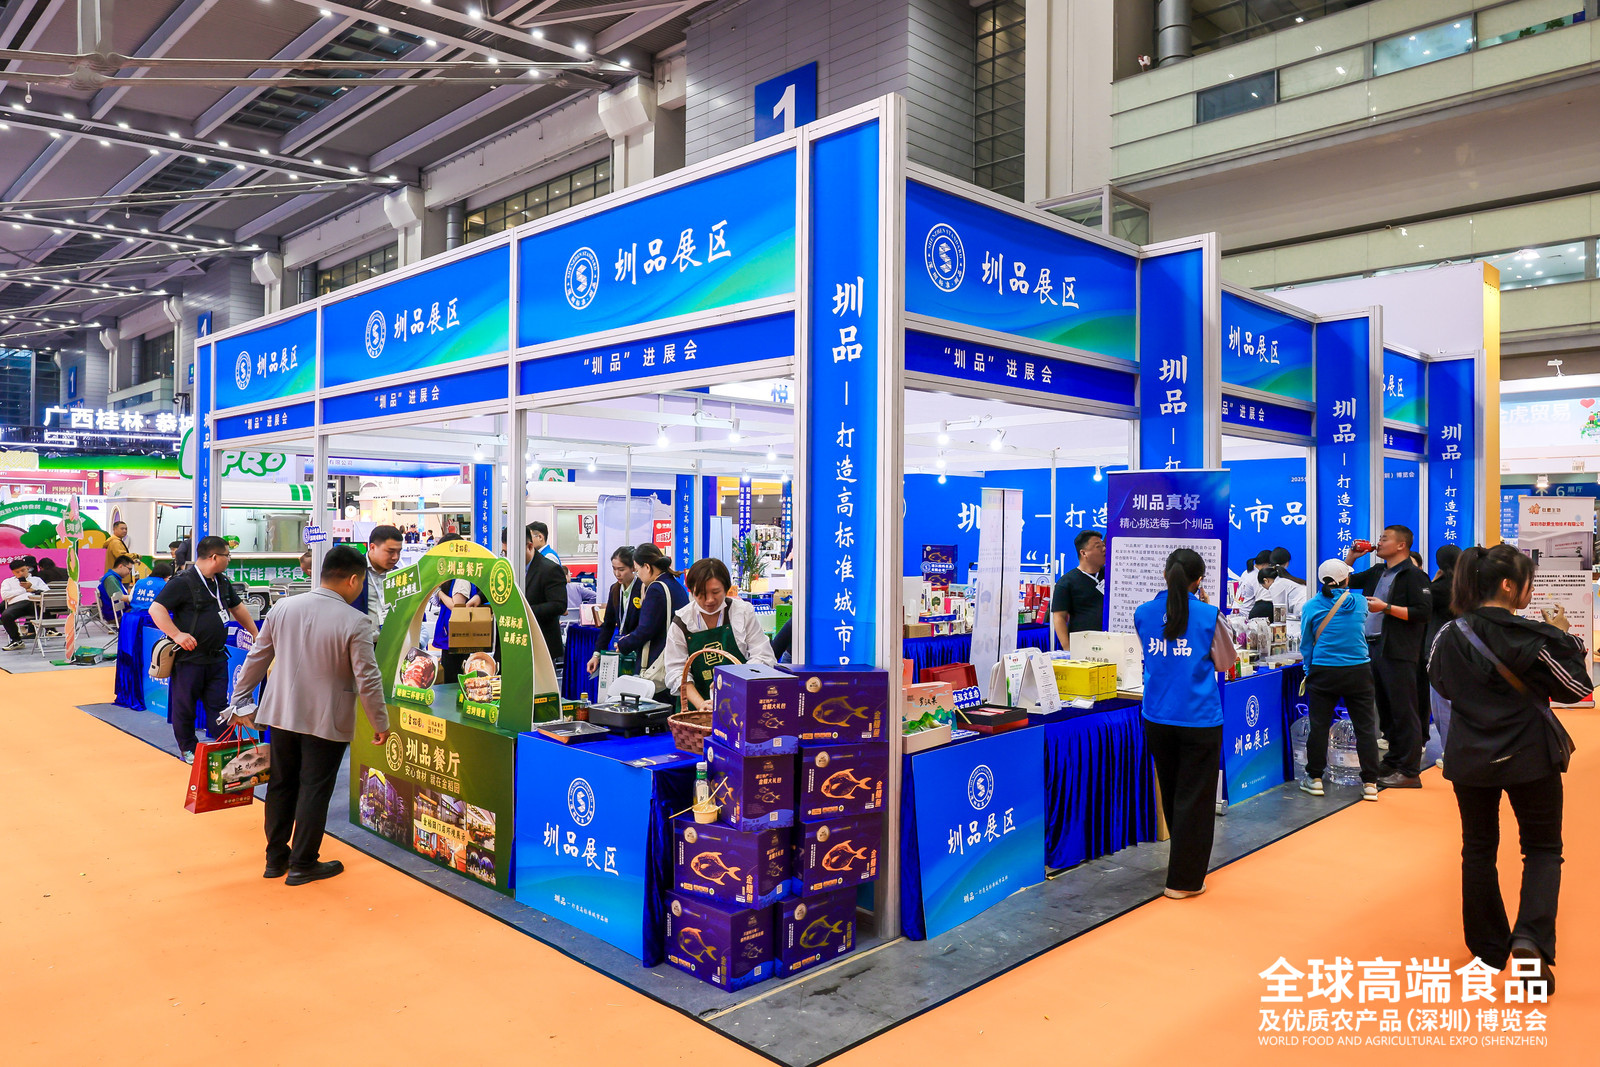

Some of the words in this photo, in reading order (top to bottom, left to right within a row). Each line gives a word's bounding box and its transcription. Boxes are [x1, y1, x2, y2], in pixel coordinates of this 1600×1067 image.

[773, 84, 795, 132] 1
[614, 219, 732, 285] 圳品展区
[982, 251, 1080, 309] 圳品展区
[394, 297, 460, 342] 圳品展区
[257, 344, 298, 378] 圳品展区
[1229, 325, 1280, 364] 圳品展区
[1132, 493, 1201, 511] 圳品真好
[1441, 423, 1462, 545] 圳品—打造高标
[1119, 517, 1214, 530] 精心挑选每一个圳品
[447, 560, 484, 578] 圳品餐厅
[1148, 637, 1192, 657] 圳品
[406, 737, 460, 777] 圳品餐厅
[1234, 727, 1270, 757] 圳品展区
[405, 765, 427, 782] 安心食材
[543, 822, 619, 876] 圳品展区
[948, 807, 1016, 855] 圳品展区
